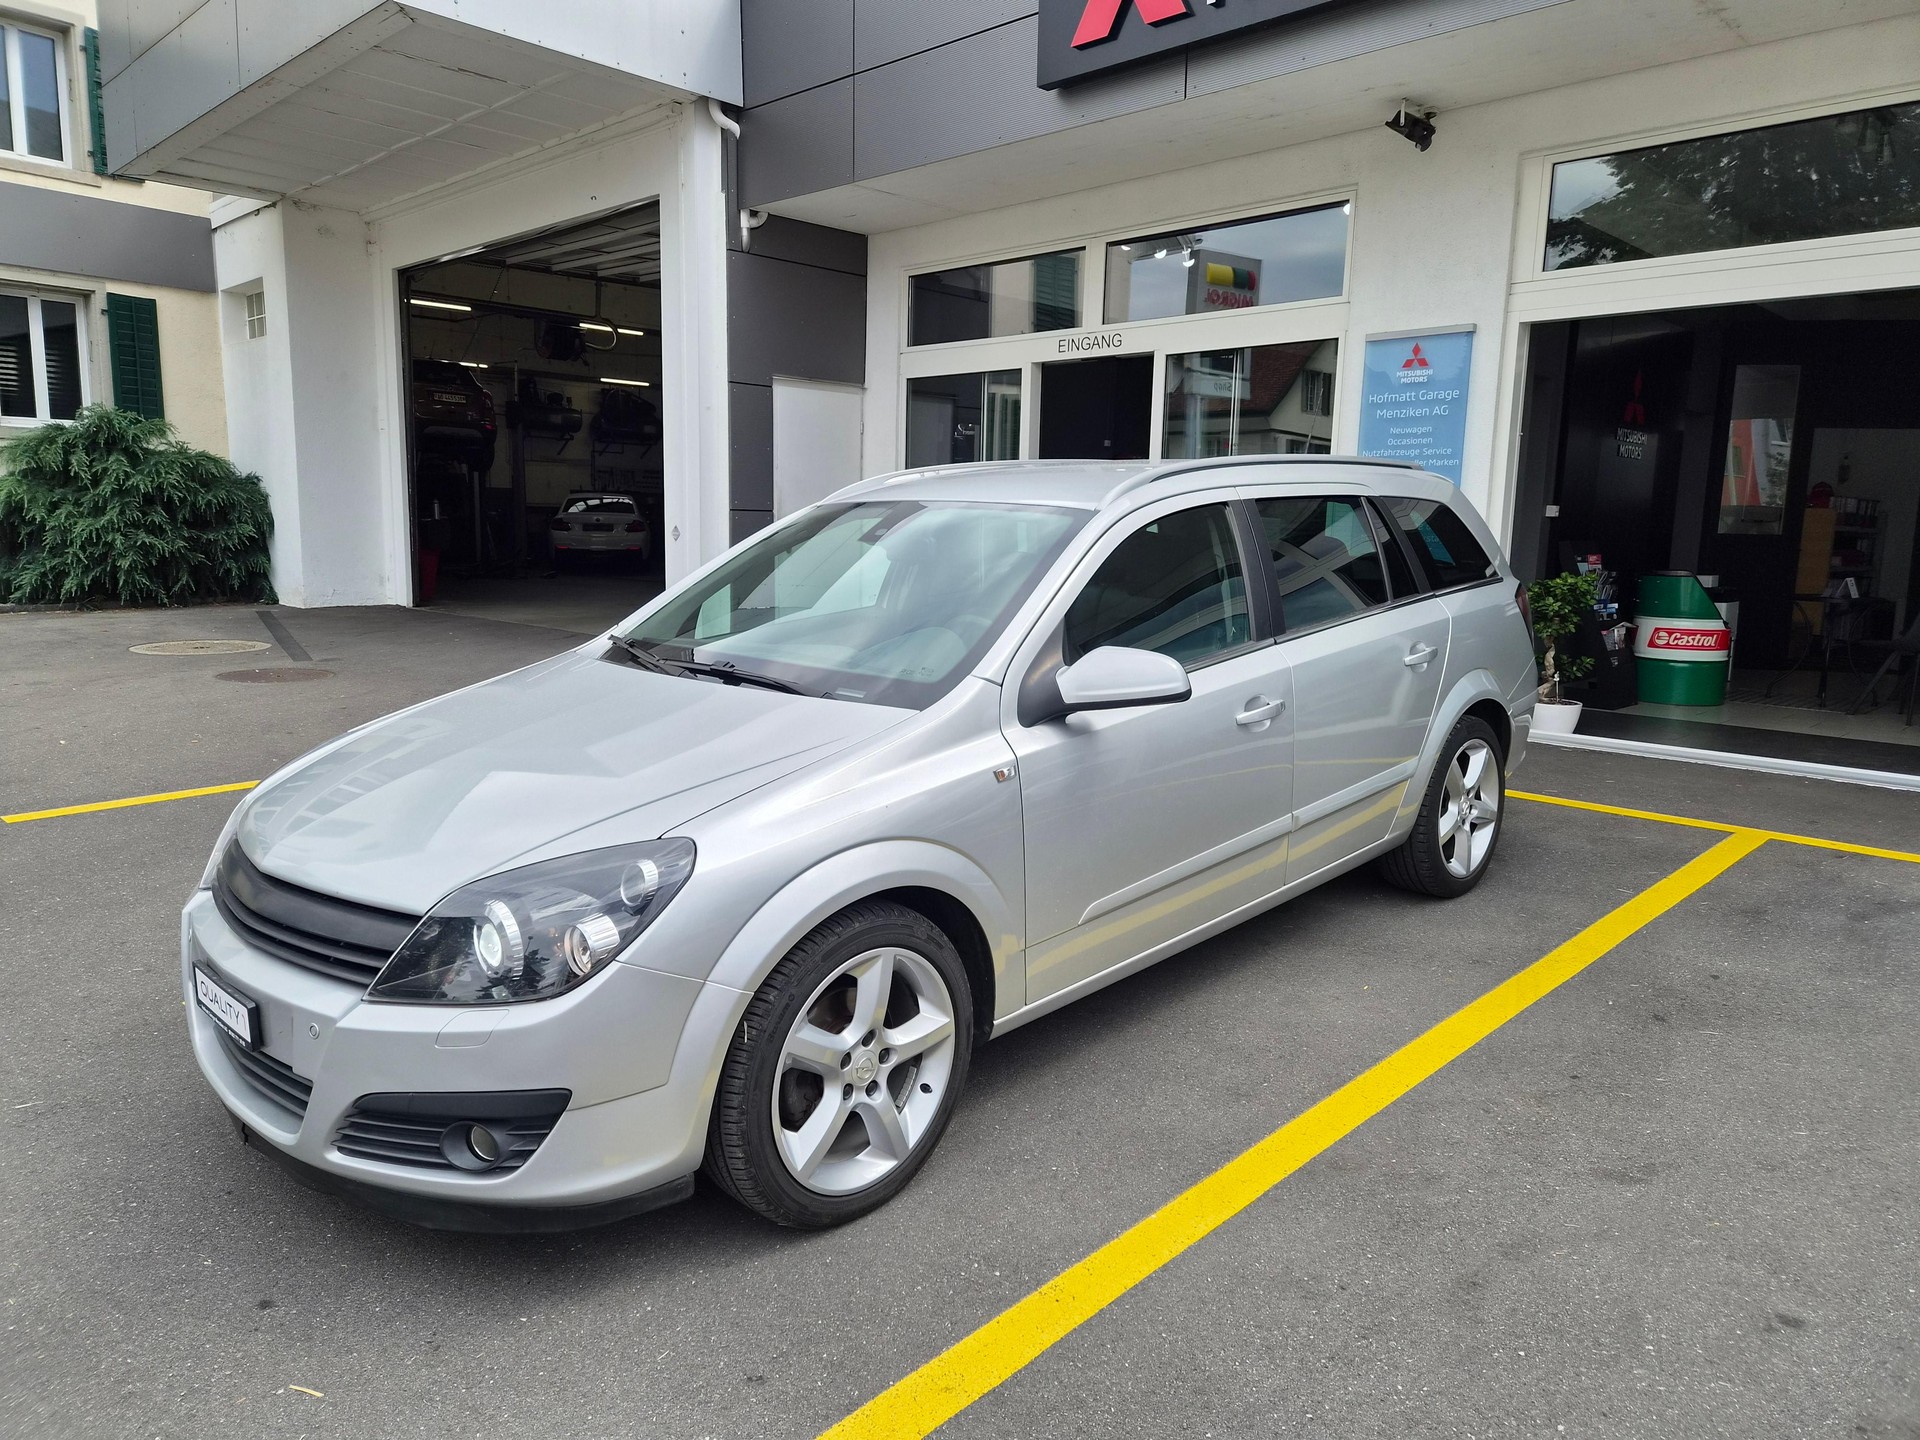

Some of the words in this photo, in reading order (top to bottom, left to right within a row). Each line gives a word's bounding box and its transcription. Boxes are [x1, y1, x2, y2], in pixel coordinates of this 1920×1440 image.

[1058, 333, 1122, 353] EINGANG
[1396, 368, 1434, 377] MITSUBISHI
[1400, 376, 1428, 384] MOTORS
[1368, 391, 1416, 404] Hofmatt
[1418, 389, 1460, 401] Garage
[1376, 407, 1429, 419] Menziken
[1432, 405, 1449, 416] AG
[1390, 425, 1432, 435] Neuwagen
[1616, 427, 1648, 445] MITSUBISHI
[1387, 437, 1433, 446] Occasionen
[1362, 448, 1420, 458] Nutzfahrzeuge
[1422, 447, 1452, 456] Service
[1619, 444, 1643, 460] MOTORS
[1428, 458, 1459, 467] Marken
[1669, 632, 1718, 647] Castrol
